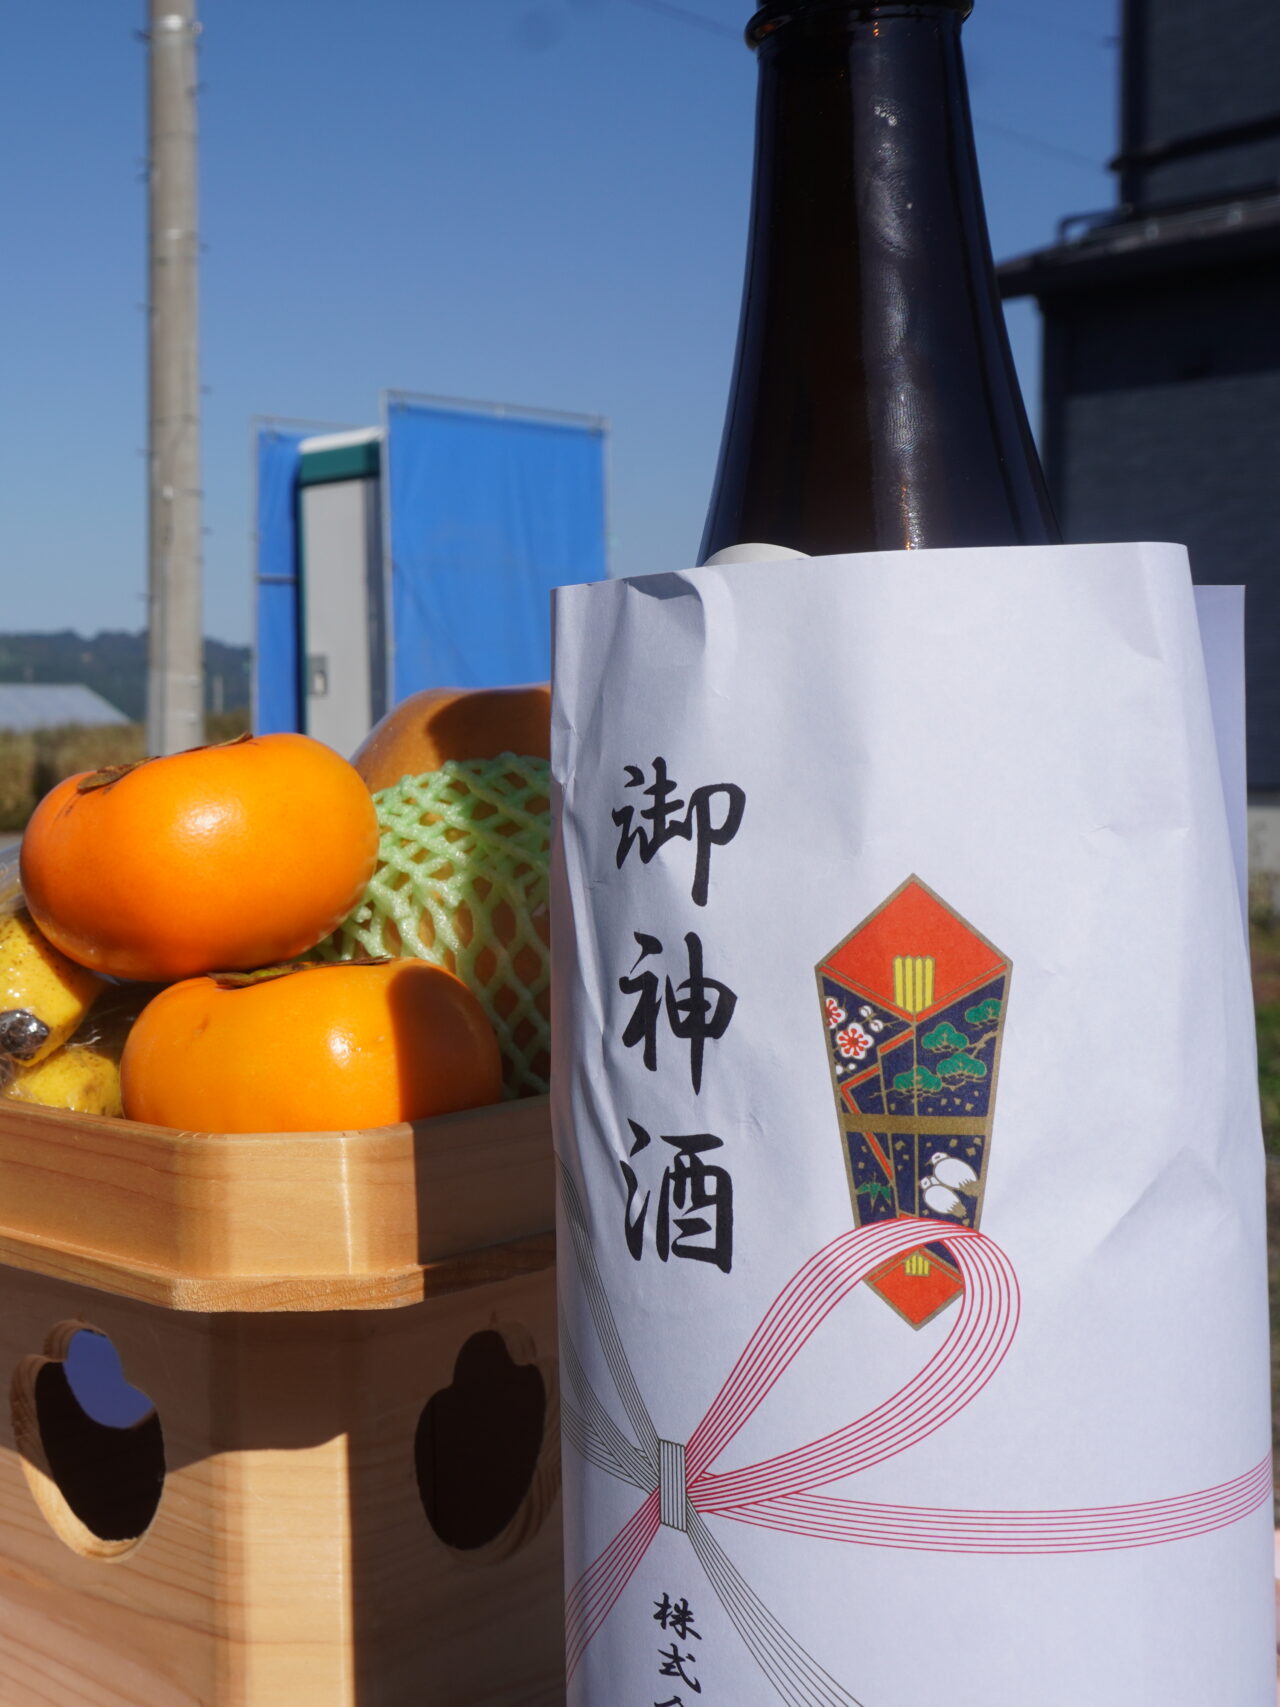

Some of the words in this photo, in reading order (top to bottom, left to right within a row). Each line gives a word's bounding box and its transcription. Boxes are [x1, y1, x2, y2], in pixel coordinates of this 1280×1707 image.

[612, 757, 746, 1275] 御神酒
[652, 1592, 703, 1707] 株式
